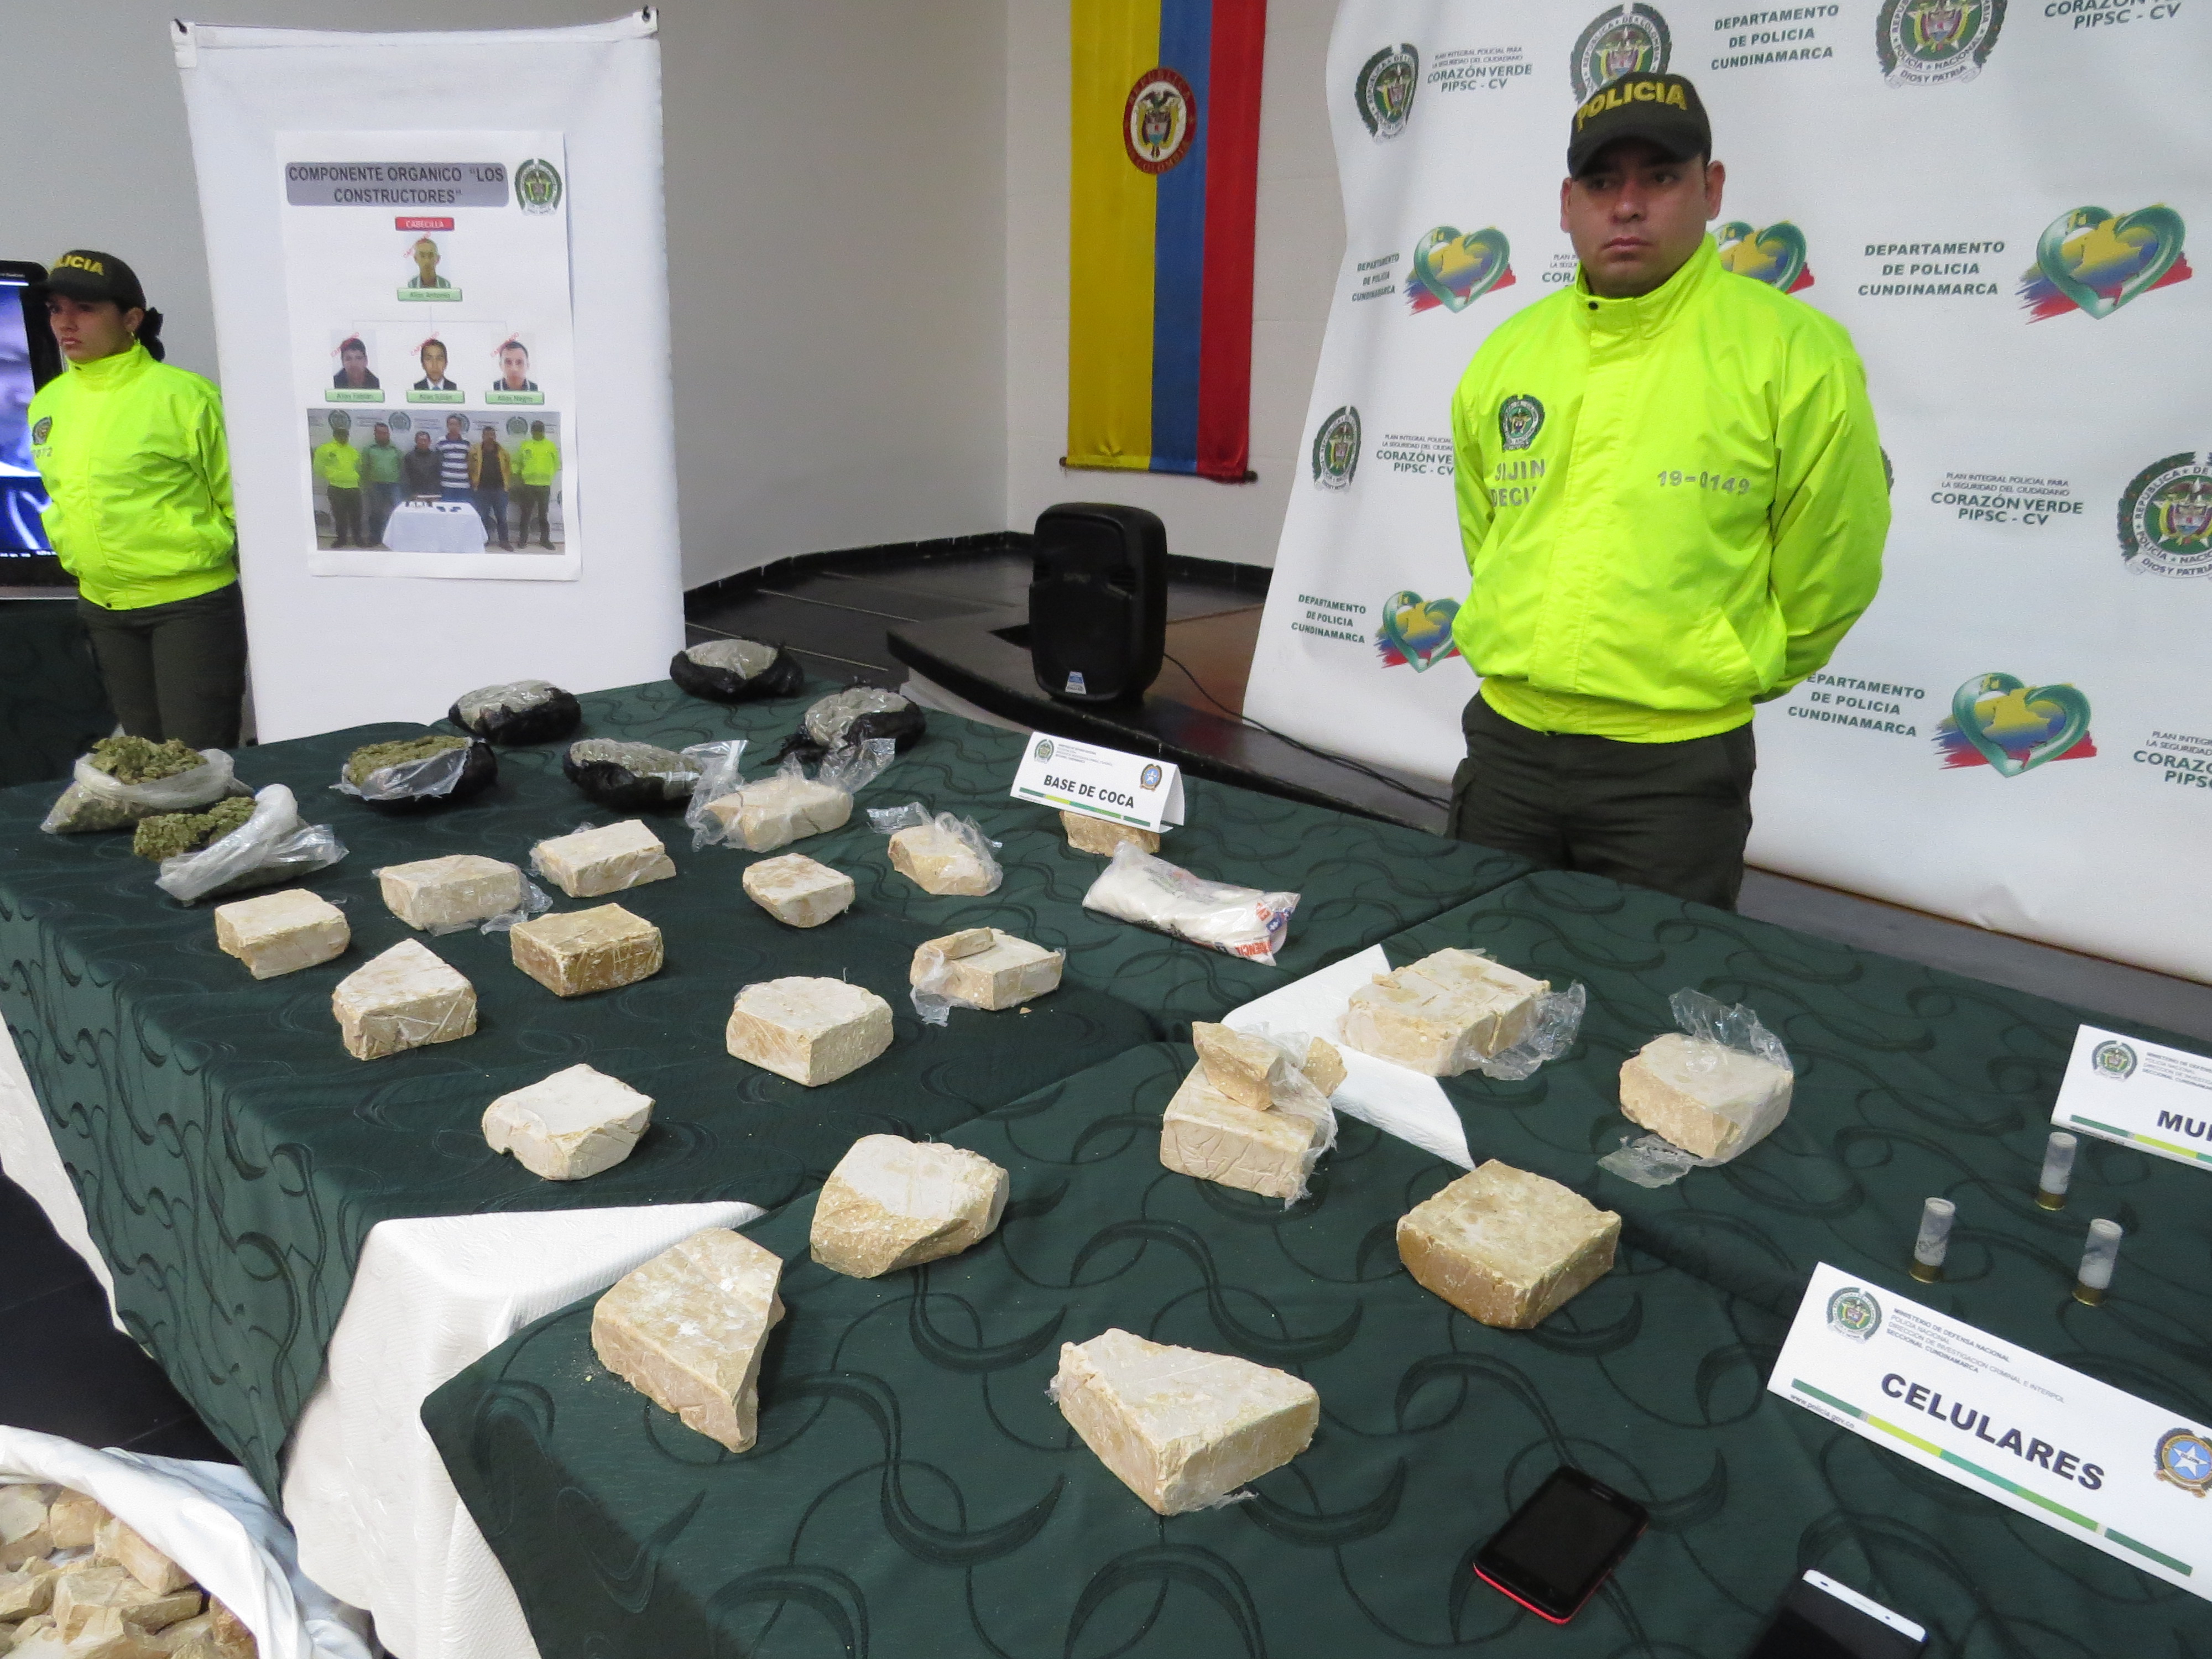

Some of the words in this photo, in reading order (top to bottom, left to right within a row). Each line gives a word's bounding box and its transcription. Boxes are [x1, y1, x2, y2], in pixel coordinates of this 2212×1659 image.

[1714, 5, 1839, 31] DEPARTAMENTO
[2074, 9, 2131, 30] PIPSC
[2150, 2, 2181, 20] CV
[1729, 35, 1747, 48] DE
[1751, 28, 1815, 46] POLICIA
[1711, 46, 1833, 70] CUNDINAMARCA
[1427, 65, 1486, 84] CORAZÓN
[1489, 64, 1532, 76] VERDE
[1441, 80, 1476, 92] PIPSC
[1489, 78, 1508, 90] CV
[1577, 81, 1687, 133] POLICIA
[289, 166, 383, 181] COMPONENTE
[387, 167, 462, 182] ORGANICO
[405, 220, 445, 229] CABECILLA
[1864, 242, 2005, 256] DEPARTAMENTO
[1882, 264, 1905, 275] DE
[1910, 263, 1980, 275] POLICIA
[1857, 283, 1999, 296] CUNDINAMARCA
[1376, 450, 1434, 463] CORAZÓN
[1394, 462, 1427, 474] PIPSC
[1657, 470, 1750, 495] 19-0149
[1931, 492, 2020, 510] CORAZÓN
[2023, 498, 2084, 515] VERDE
[1958, 508, 2008, 523] PIPSC
[2022, 512, 2049, 526] CV
[1298, 594, 1366, 614] DEPARTAMENTO
[1306, 611, 1316, 619] DE
[1317, 612, 1354, 627] POLICIA
[1291, 622, 1365, 644] CUNDINAMARCA
[1806, 672, 1926, 700] EPARTAMENTO
[1811, 691, 1832, 703] DE
[1835, 695, 1901, 715] POLICIA
[1788, 706, 1917, 737] CUNDINAMARCA
[1044, 775, 1076, 792] BASE
[1078, 784, 1096, 797] DE
[1099, 789, 1134, 808] COCA
[1887, 1328, 1923, 1349] SECCIONAL
[1925, 1345, 1979, 1373] CUNDINAMARCA
[1943, 1330, 1974, 1347] DEFENSA
[1976, 1343, 2010, 1363] NACIONAL
[1881, 1372, 2105, 1491] CELULARES
